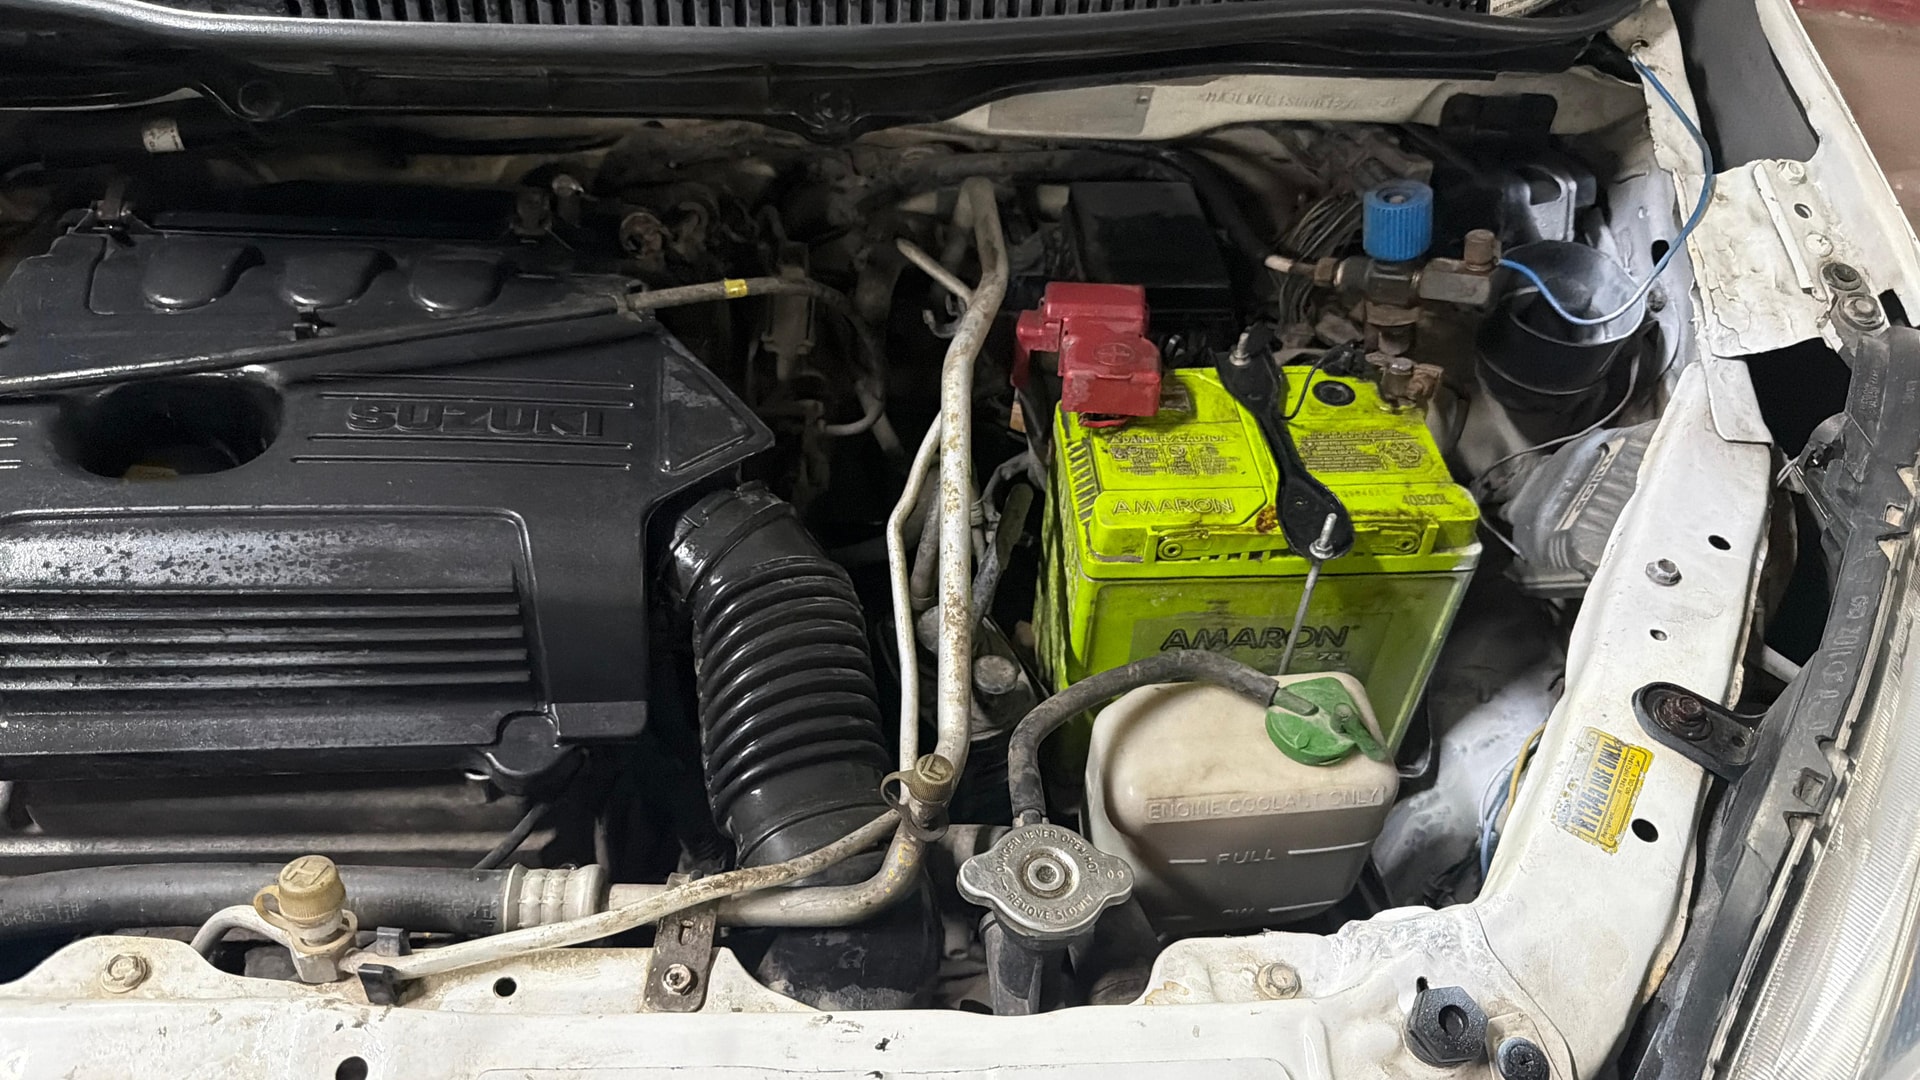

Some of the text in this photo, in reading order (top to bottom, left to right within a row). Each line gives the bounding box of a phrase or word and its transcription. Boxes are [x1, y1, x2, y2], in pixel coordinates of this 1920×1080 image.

[347, 404, 603, 437] SUZUKI
[1113, 497, 1235, 514] AMARON
[1160, 625, 1350, 652] AMARON
[1597, 741, 1622, 770] ONLY
[1590, 766, 1614, 791] USE
[1149, 799, 1222, 819] ENGINE
[1328, 787, 1378, 804] ONLY
[1021, 829, 1058, 841] NEVER
[1060, 833, 1086, 855] OPEN
[1083, 853, 1100, 875] HOT
[1216, 848, 1277, 865] FULL
[1006, 891, 1094, 920] REMOVE SLOWLY
